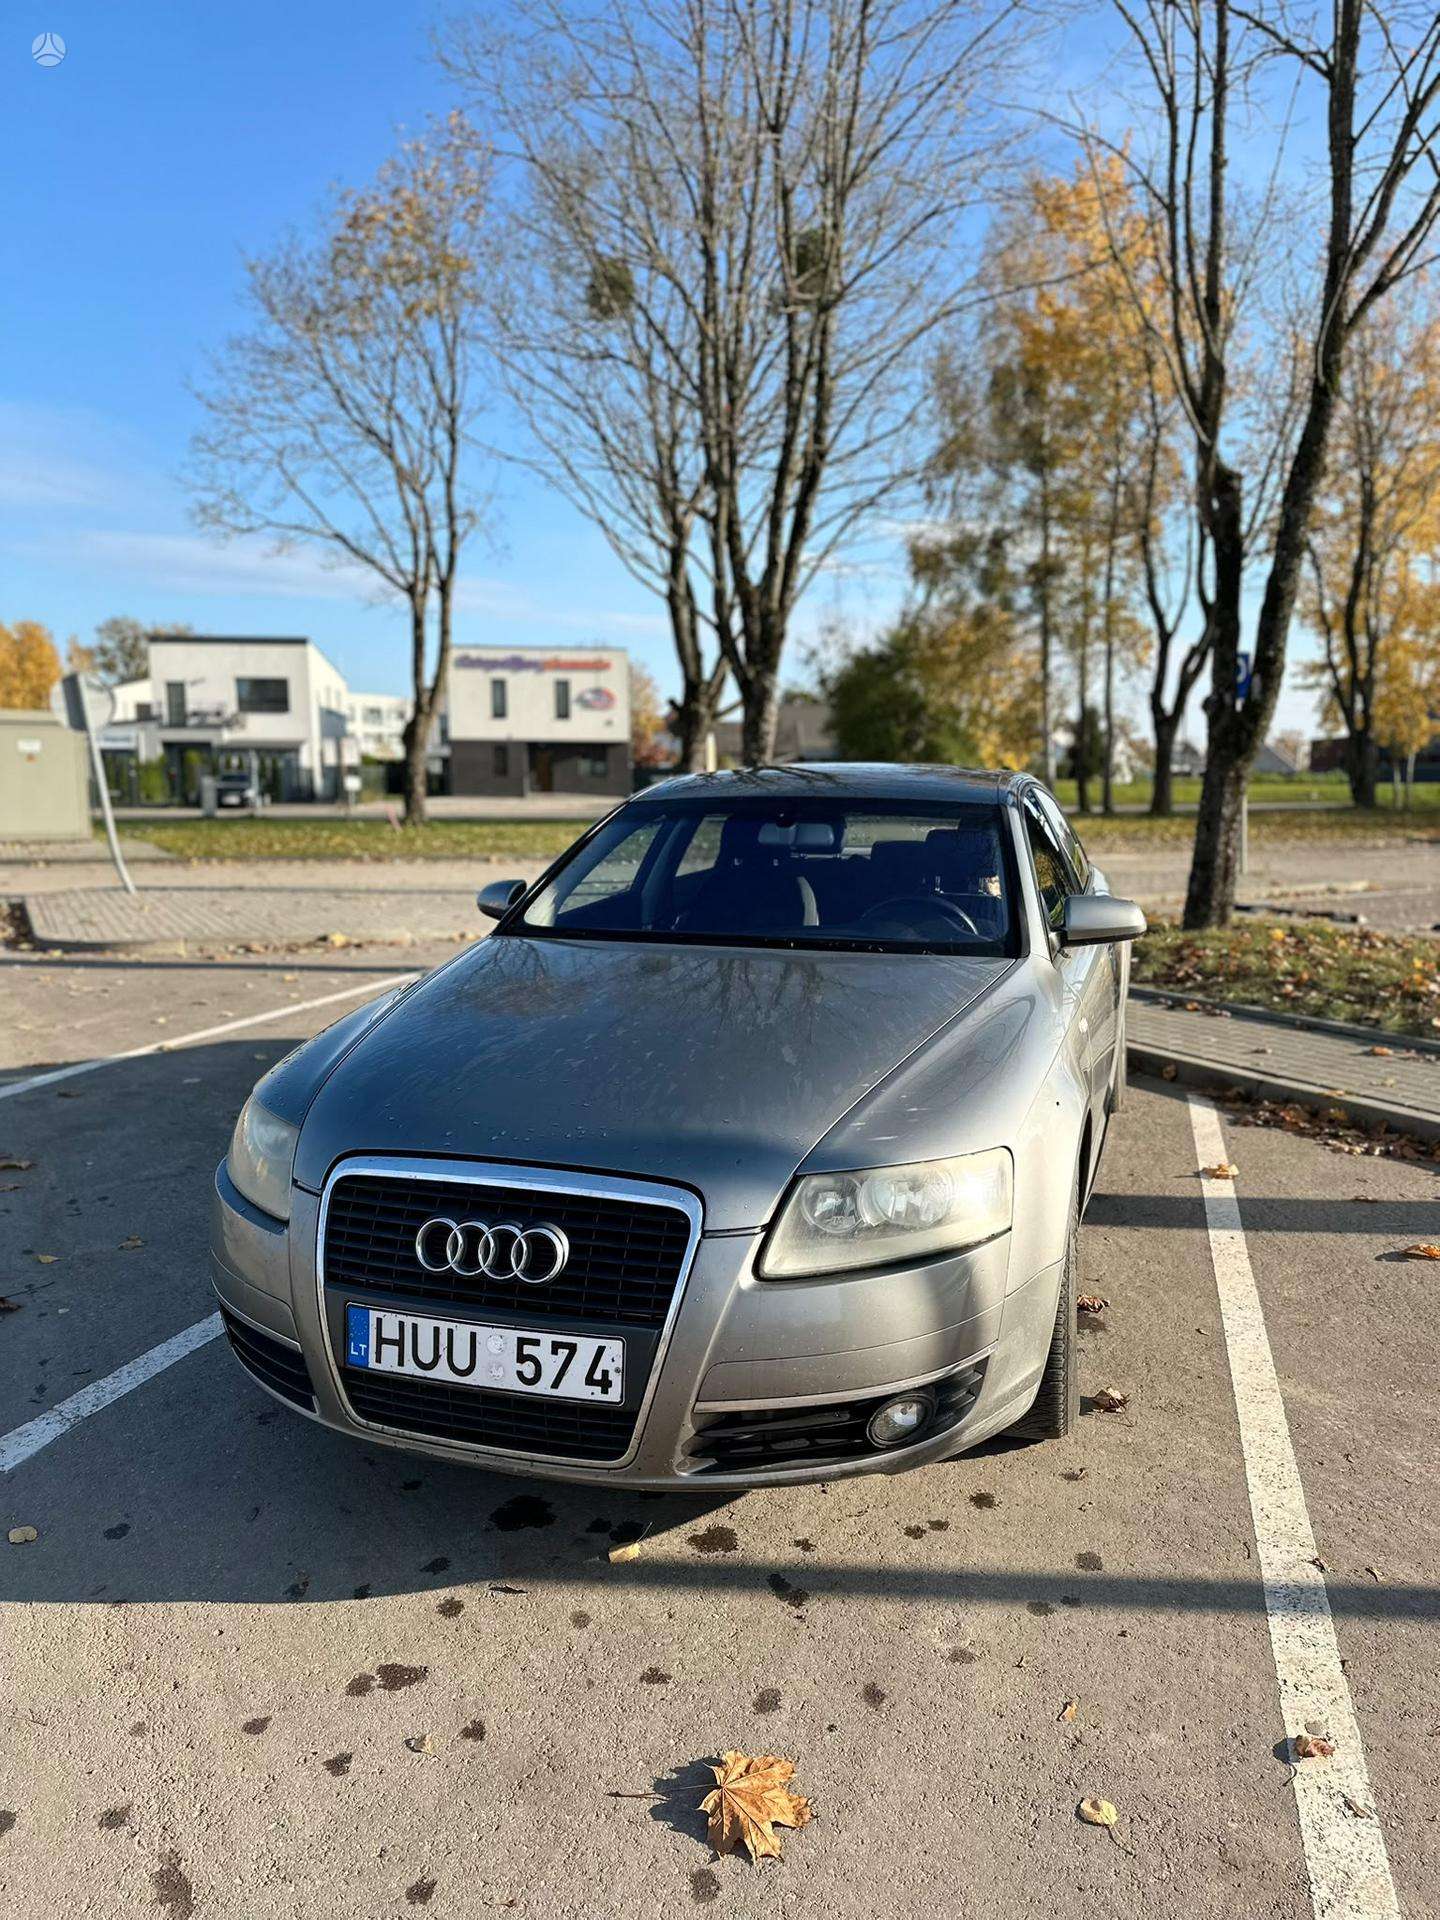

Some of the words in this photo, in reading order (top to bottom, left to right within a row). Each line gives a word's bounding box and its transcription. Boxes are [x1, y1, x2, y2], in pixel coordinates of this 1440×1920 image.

[350, 1341, 367, 1356] LT
[375, 1316, 477, 1378] HUU
[516, 1336, 613, 1396] 574
